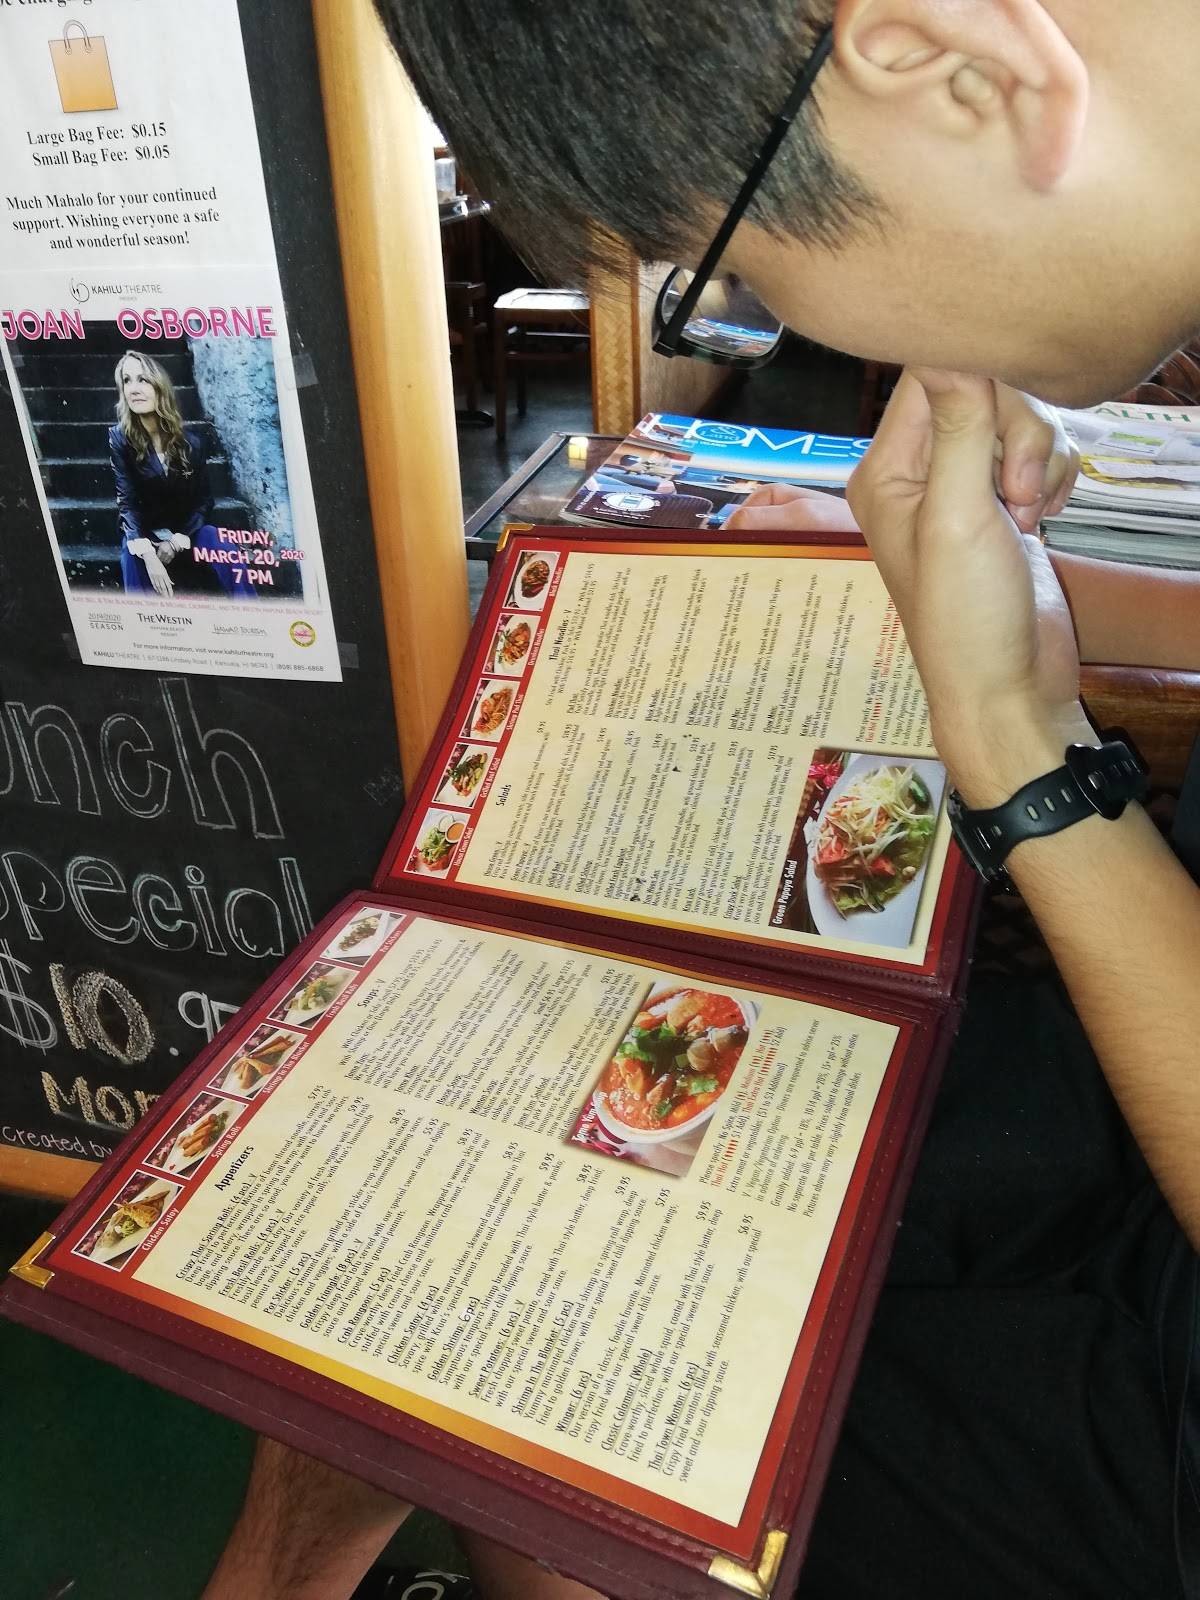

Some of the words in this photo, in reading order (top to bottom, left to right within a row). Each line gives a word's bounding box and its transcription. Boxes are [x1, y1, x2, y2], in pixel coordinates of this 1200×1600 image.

[27, 129, 64, 147] Large
[68, 127, 94, 145] Bag
[97, 125, 124, 141] Fee:
[131, 122, 167, 139] $0.15
[32, 150, 69, 167] Small
[74, 149, 98, 166] Bag
[101, 147, 128, 163] Fee:
[136, 144, 170, 161] $0.05
[6, 195, 43, 211] Much
[46, 193, 94, 209] Mahalo
[97, 190, 115, 206] for
[119, 190, 149, 208] your
[152, 187, 217, 204] continued
[12, 216, 64, 234] support.
[66, 213, 120, 231] Wishing
[122, 211, 180, 229] everyone
[183, 212, 191, 223] a
[194, 208, 220, 223] safe
[49, 235, 73, 250] and
[76, 231, 140, 249] wonderful
[143, 231, 189, 246] season!
[91, 284, 123, 294] KAHILU
[124, 284, 163, 294] THEATRE
[1, 309, 85, 341] JOAN
[116, 306, 278, 341] OSBORNE
[216, 527, 274, 547] FRIDAY,
[193, 547, 249, 565] MARCH
[253, 548, 281, 568] 20,
[280, 550, 305, 562] 2020
[232, 568, 243, 584] 7
[248, 569, 274, 585] PM
[90, 622, 124, 631] SEASON
[136, 613, 156, 624] THE
[155, 614, 192, 626] WESTIN
[553, 619, 569, 644] Noodles
[548, 646, 560, 660] Thai
[511, 704, 520, 713] Pad
[0, 677, 285, 839] nch
[479, 782, 490, 797] Grilled
[494, 783, 512, 806] Salads
[784, 859, 797, 878] Salad
[778, 879, 793, 904] Papaya
[0, 851, 313, 958] pecial
[772, 904, 785, 924] Green
[356, 987, 380, 1008] Soups
[581, 1106, 599, 1123] Yum
[2, 1125, 86, 1155] created
[210, 1138, 231, 1158] Spring
[225, 1124, 242, 1139] Rolls
[571, 1121, 592, 1142] Tome
[212, 1144, 257, 1192] Appetizers
[140, 1225, 165, 1251] Chicken
[174, 1257, 197, 1280] Crispy
[189, 1242, 206, 1258] Thai
[200, 1220, 224, 1244] Spring
[235, 1181, 253, 1196] pcs)
[217, 1276, 237, 1296] Fresh
[231, 1259, 249, 1277] Basil
[262, 1217, 280, 1233] pcs)
[262, 1300, 277, 1314] Pot
[293, 1250, 312, 1267] pcs)
[298, 1302, 322, 1329] Golden
[340, 1247, 358, 1264] pcs)
[336, 1325, 354, 1344] Crab
[373, 1265, 392, 1283] pcs)
[385, 1334, 410, 1365] Chicken
[421, 1283, 440, 1302] pcs)
[425, 1351, 449, 1381] Golden
[467, 1372, 488, 1398] Sweet
[503, 1309, 521, 1328] pcs)
[510, 1383, 534, 1415] Shrimp
[529, 1358, 545, 1375] The
[556, 1299, 574, 1317] pcs)
[574, 1368, 593, 1389] pcs)
[681, 1360, 700, 1381] pcs)
[600, 1420, 622, 1452] Classic
[629, 1346, 653, 1381] (Whole)
[700, 1382, 723, 1418] dipping
[654, 1425, 674, 1450] Town
[693, 1416, 709, 1438] sour
[685, 1436, 702, 1456] and
[647, 1448, 665, 1471] Thai
[676, 1455, 695, 1483] sweet
